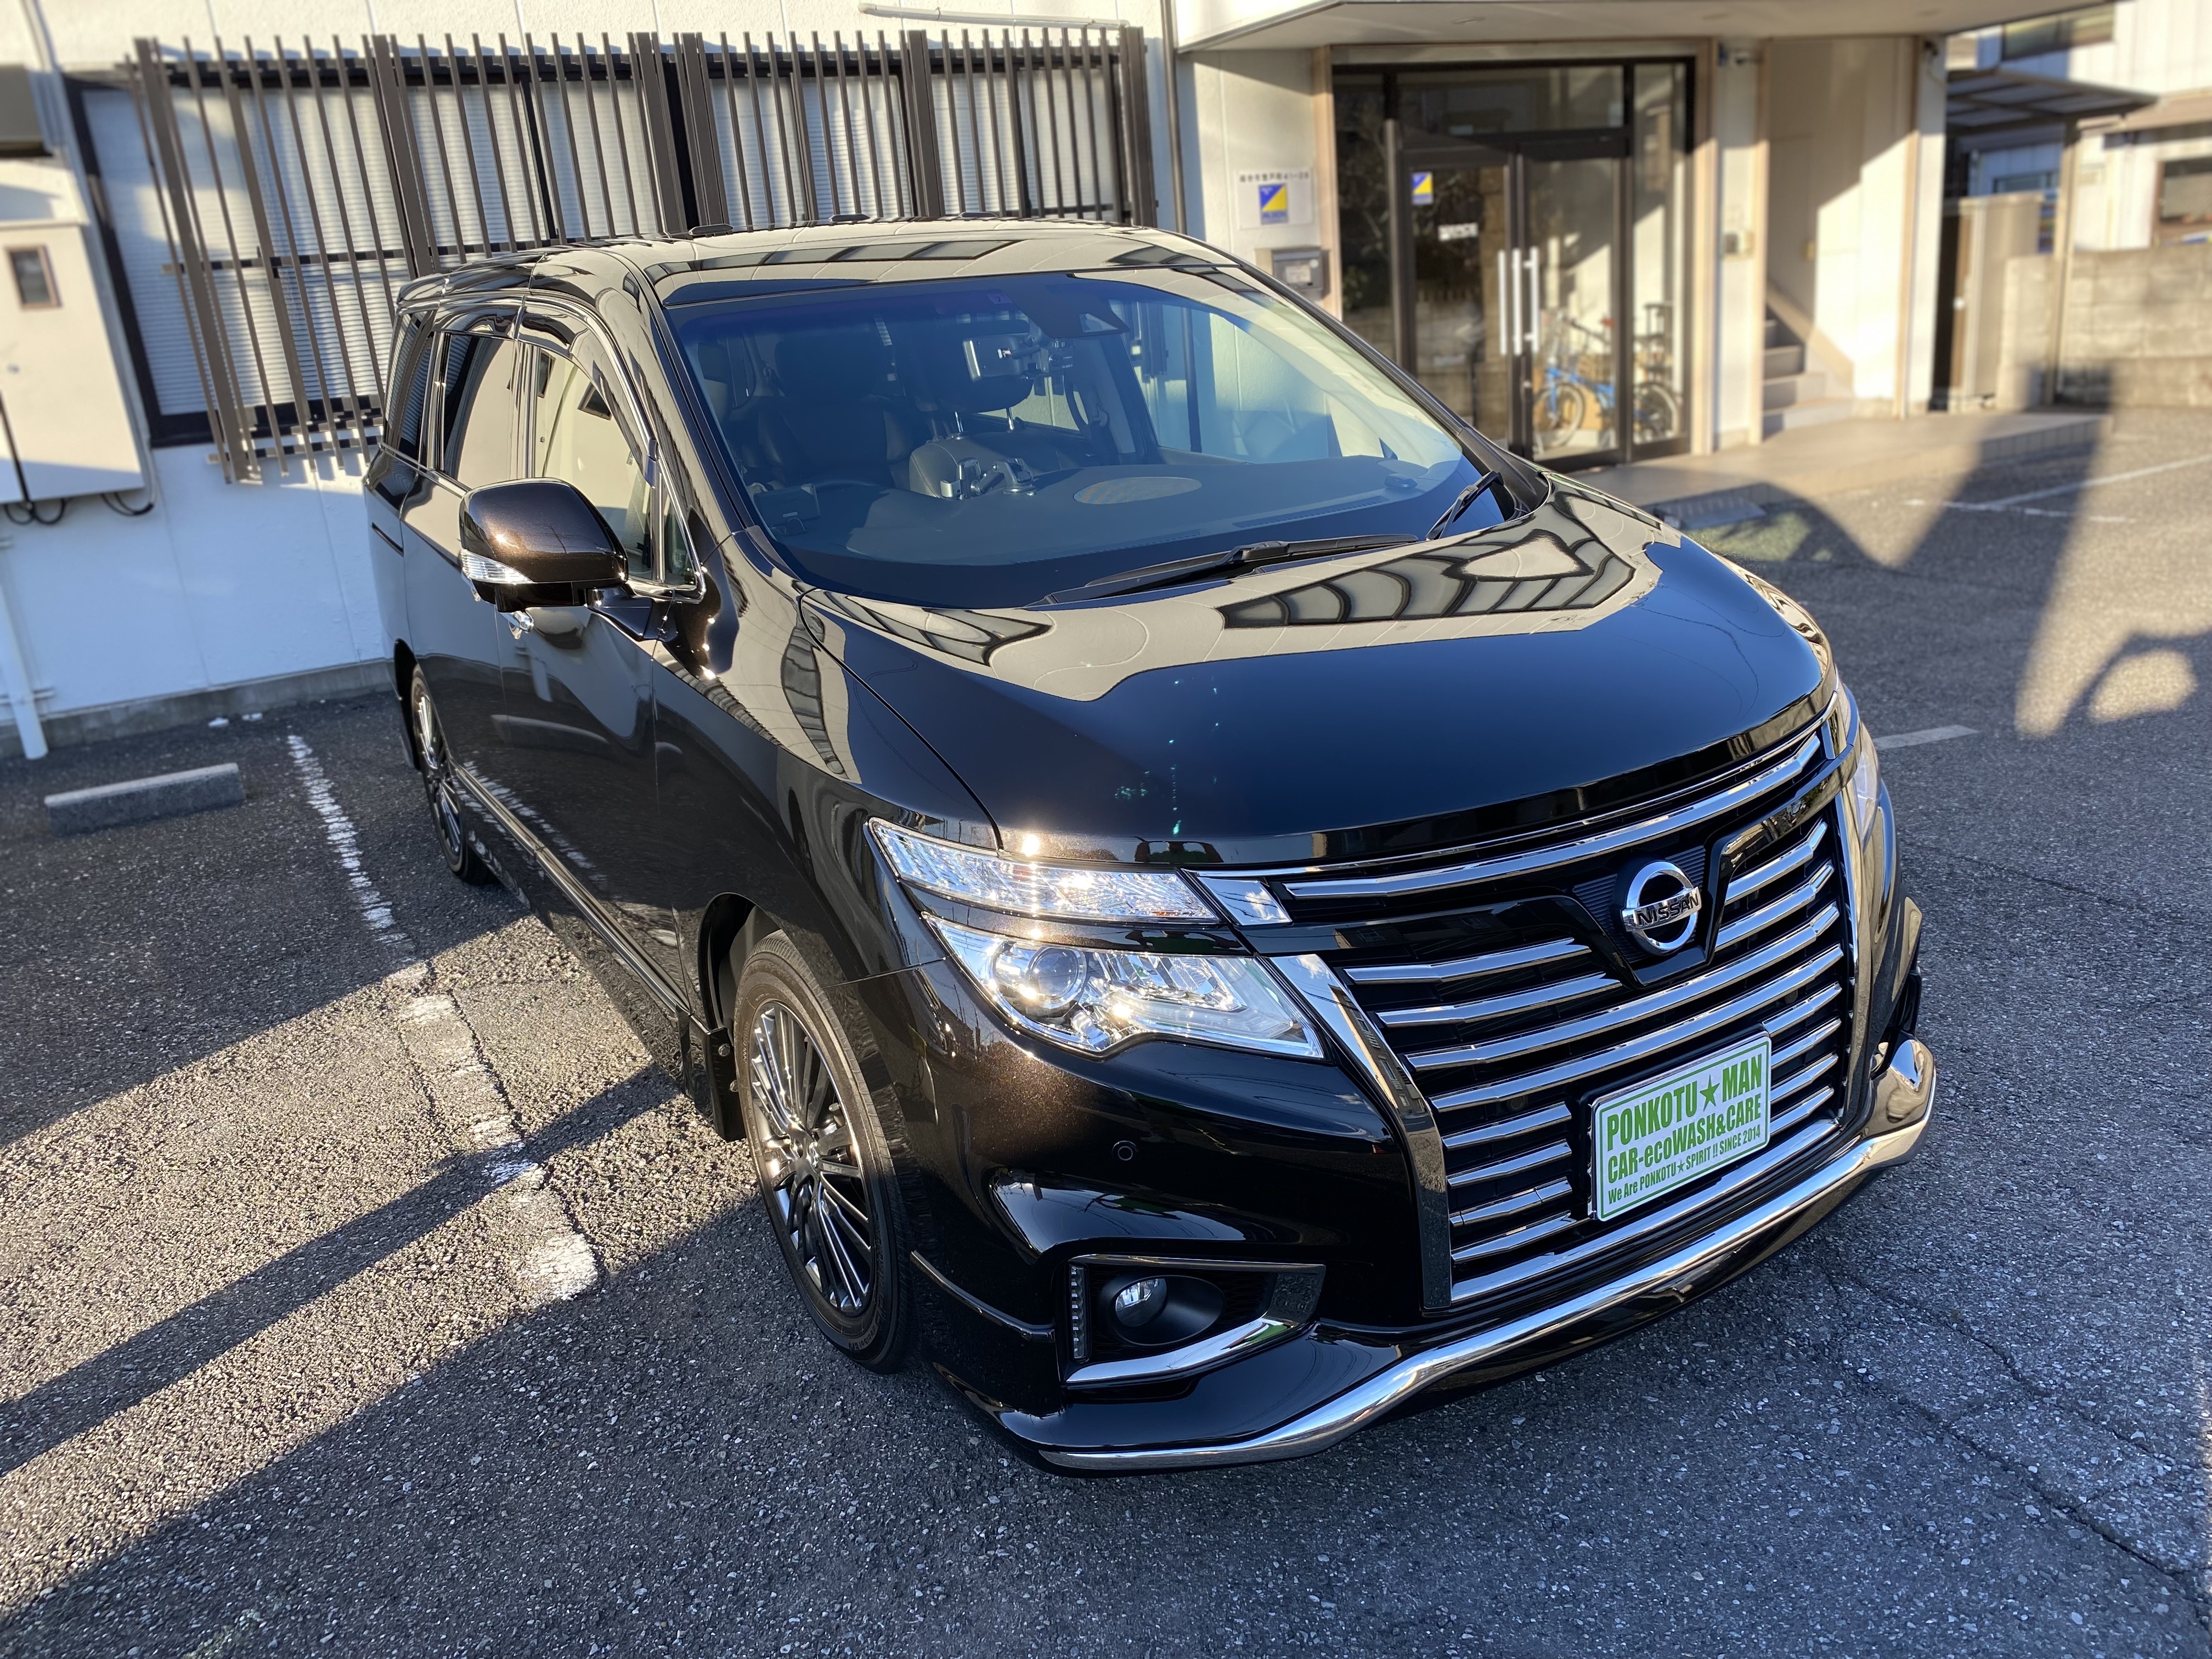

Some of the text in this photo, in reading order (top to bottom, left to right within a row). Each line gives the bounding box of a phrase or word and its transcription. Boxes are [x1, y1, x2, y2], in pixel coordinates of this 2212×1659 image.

[1637, 893, 1699, 926] NISSAN
[1607, 1053, 1762, 1152] PONKOTU MAN
[1608, 1187, 1622, 1205] We
[1623, 1181, 1638, 1198] Are
[1639, 1161, 1677, 1191] PONKOTU
[1686, 1146, 1711, 1170] SPIRIT
[1719, 1132, 1741, 1155] SINCE
[1742, 1124, 1761, 1145] 2014
